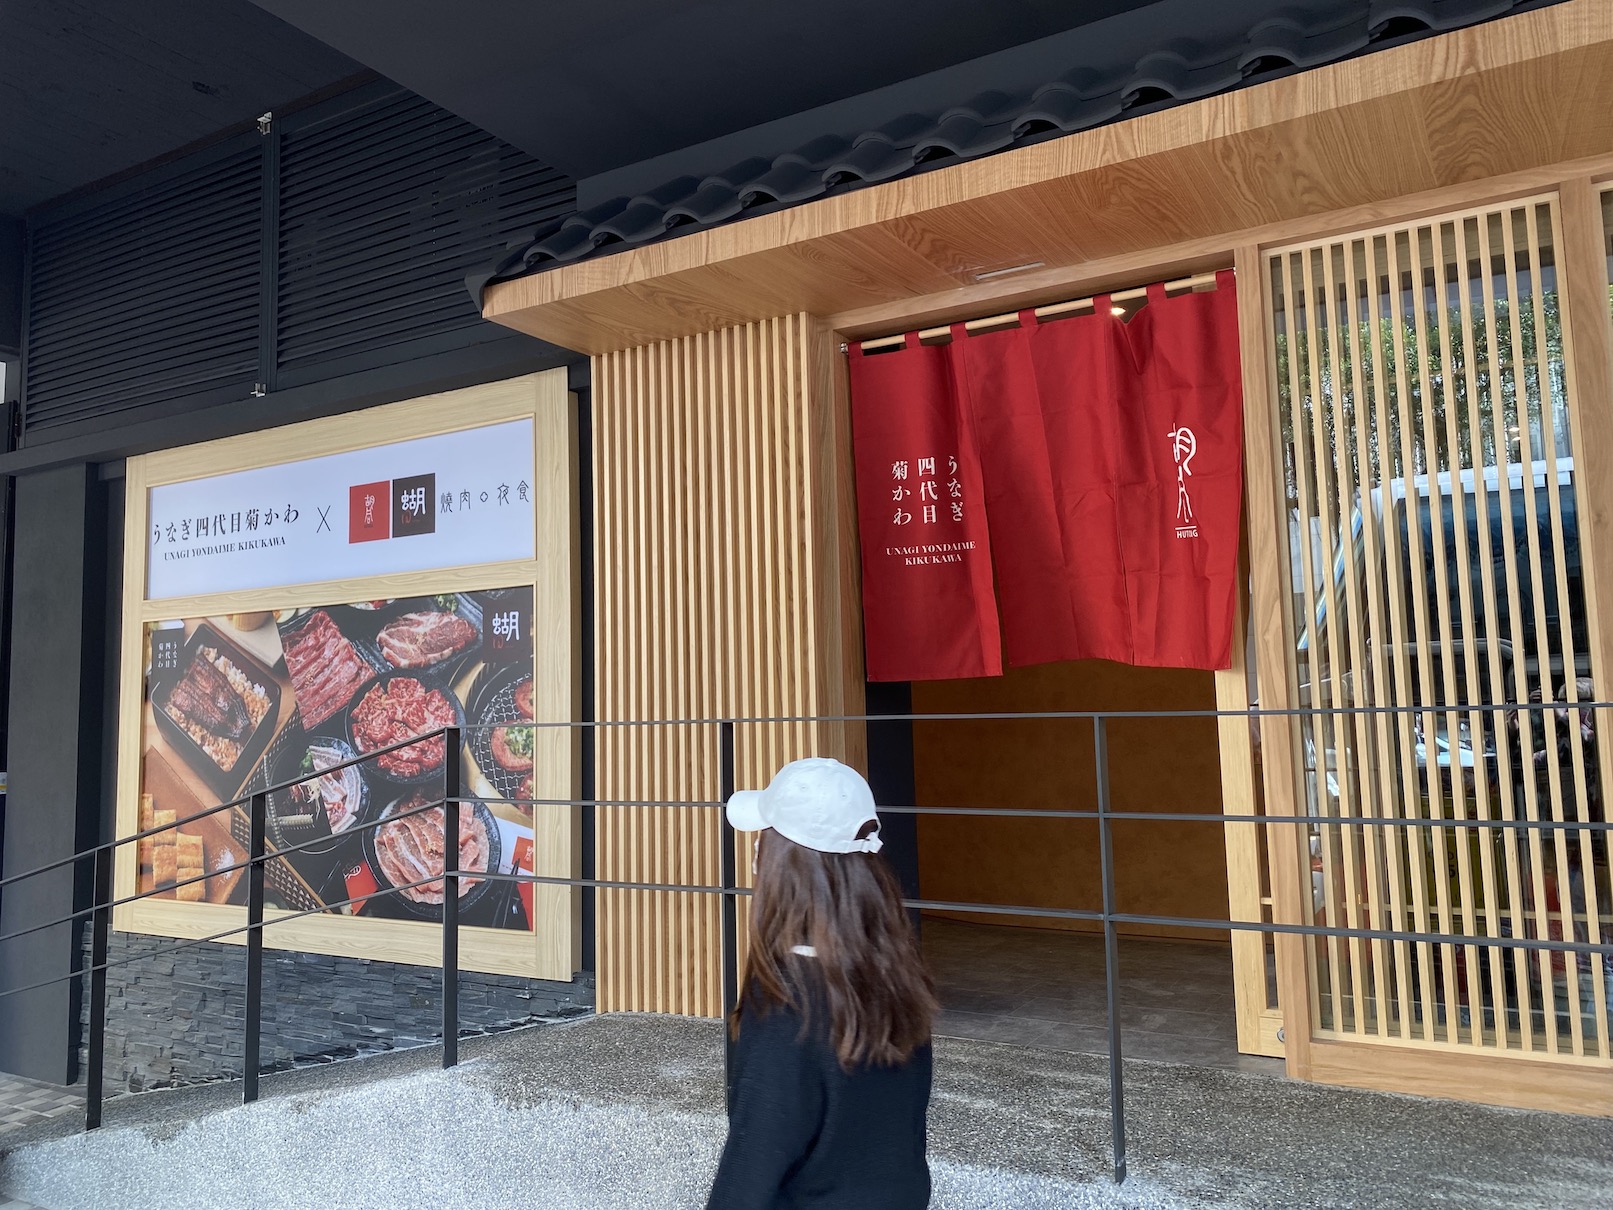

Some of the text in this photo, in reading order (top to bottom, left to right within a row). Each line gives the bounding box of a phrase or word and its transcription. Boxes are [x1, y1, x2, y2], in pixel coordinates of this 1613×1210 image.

[891, 461, 912, 525] 菊かわ
[918, 457, 938, 524] 四代目
[947, 456, 963, 521] うなぎ
[154, 504, 299, 545] うなぎ四代目菊かわ
[164, 536, 286, 561] UNAGI YONDAIME KIKUKAWA
[886, 541, 976, 555] UNAGI YONDAIME
[905, 554, 962, 566] KIKUKAWA
